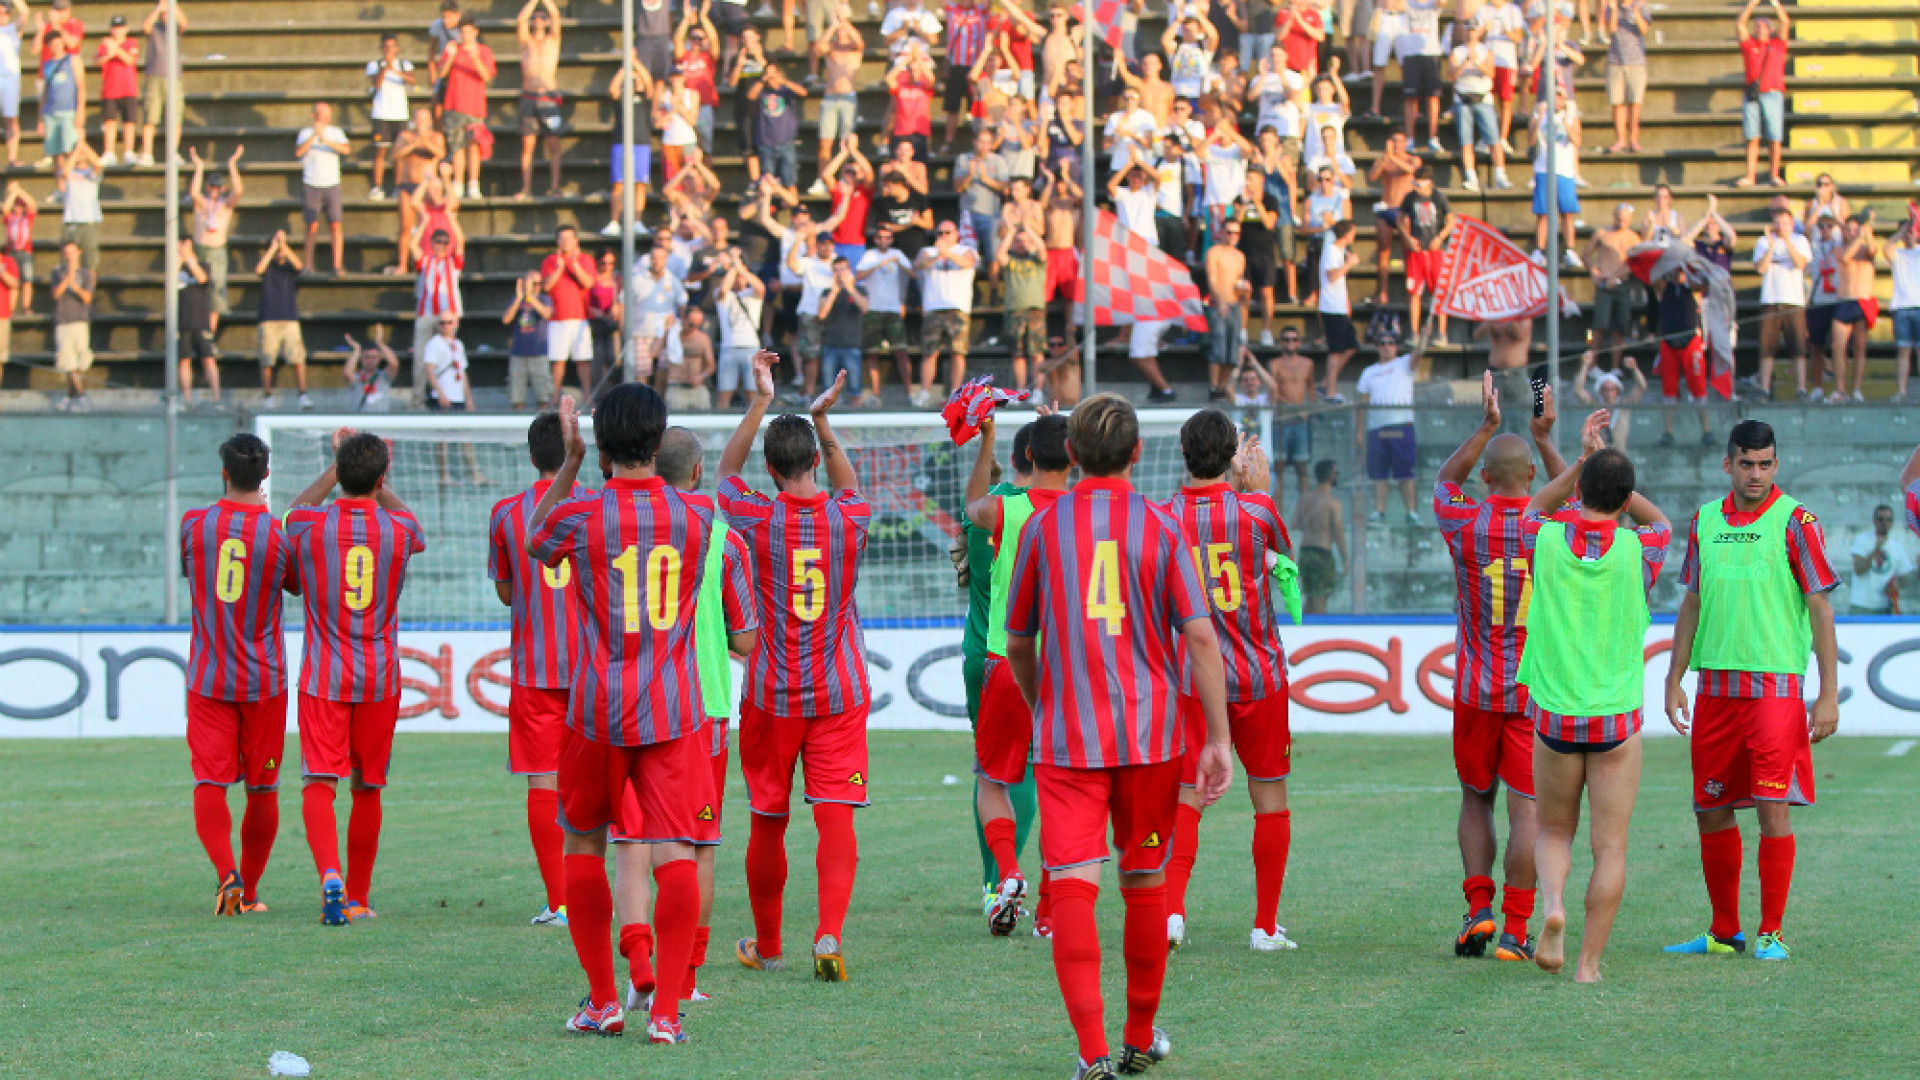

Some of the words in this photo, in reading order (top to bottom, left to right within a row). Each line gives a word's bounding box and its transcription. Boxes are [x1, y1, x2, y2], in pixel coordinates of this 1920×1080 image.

[217, 538, 246, 603] 6
[344, 545, 374, 610] 9
[612, 545, 681, 633] 10
[792, 548, 826, 622] 5
[1086, 540, 1126, 636] 4
[1483, 558, 1533, 626] 17
